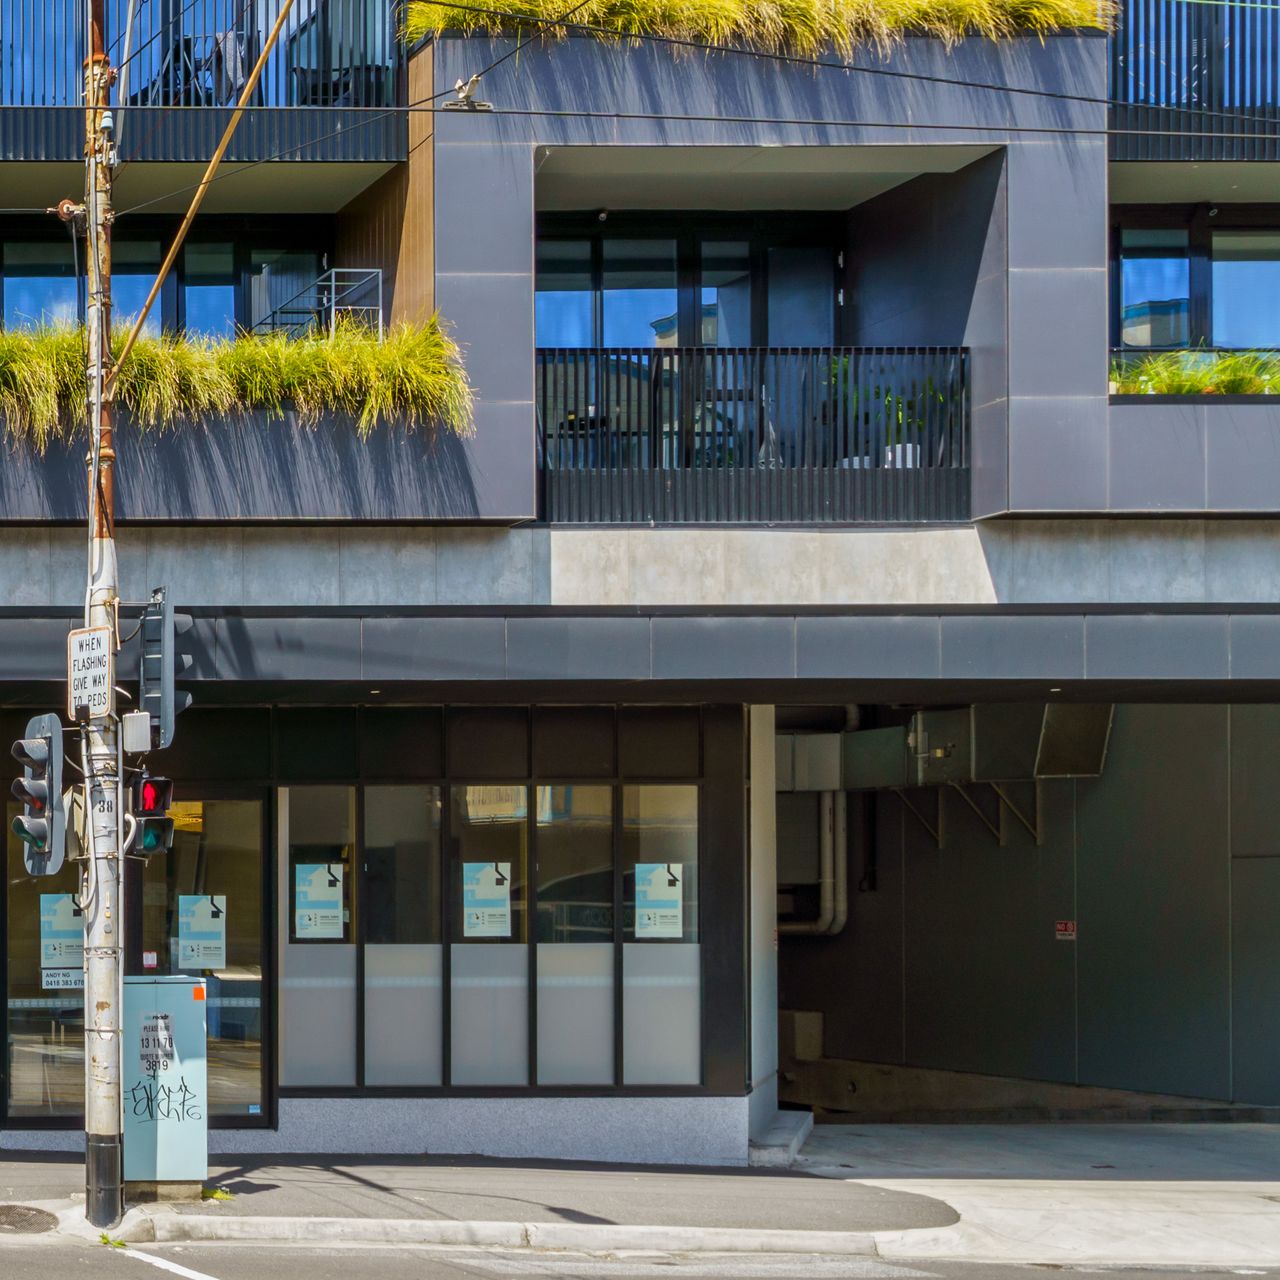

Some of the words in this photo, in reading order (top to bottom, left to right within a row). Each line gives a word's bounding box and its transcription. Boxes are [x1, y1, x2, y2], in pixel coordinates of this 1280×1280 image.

[78, 637, 102, 652] WHEN
[73, 655, 107, 672] FLASHING
[73, 677, 88, 691] GIVE
[92, 674, 106, 688] WAY
[73, 696, 82, 707] TO
[88, 692, 107, 707] PEDS
[99, 800, 113, 813] 38
[141, 1038, 150, 1048] 13
[153, 1038, 160, 1048] 11
[163, 1037, 173, 1048] 70
[146, 1060, 168, 1071] 3819
